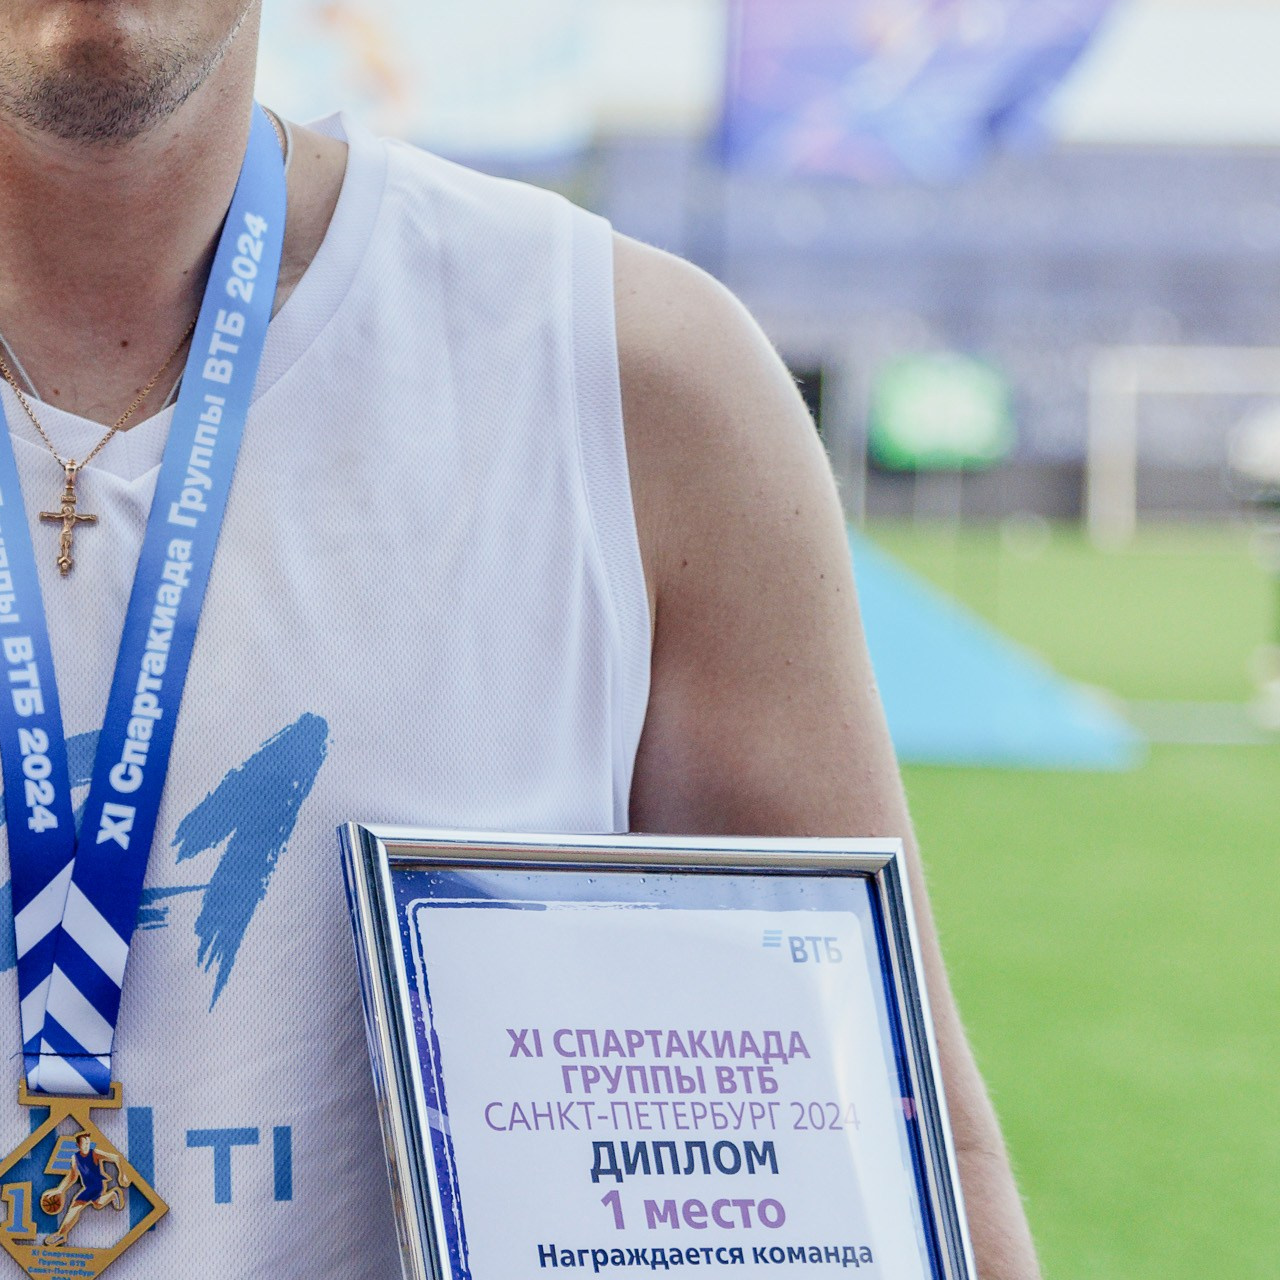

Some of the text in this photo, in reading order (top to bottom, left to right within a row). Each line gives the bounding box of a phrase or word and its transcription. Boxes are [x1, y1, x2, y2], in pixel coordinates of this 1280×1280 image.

[96, 212, 268, 850] XI Спартакиада Группы ВТБ 2024
[3, 636, 44, 717] ВТБ
[18, 727, 58, 833] 2024
[788, 935, 843, 964] ВТБ
[506, 1028, 811, 1064] XI СПАРТАКИАДА
[561, 1065, 779, 1094] ГРУППЫ ВТБ
[484, 1101, 861, 1132] САНКТ-ПЕТЕРБУРГ 2024
[590, 1140, 780, 1183] ДИПЛОМ
[600, 1189, 787, 1230] 1 место
[537, 1244, 874, 1273] Награждается команда
